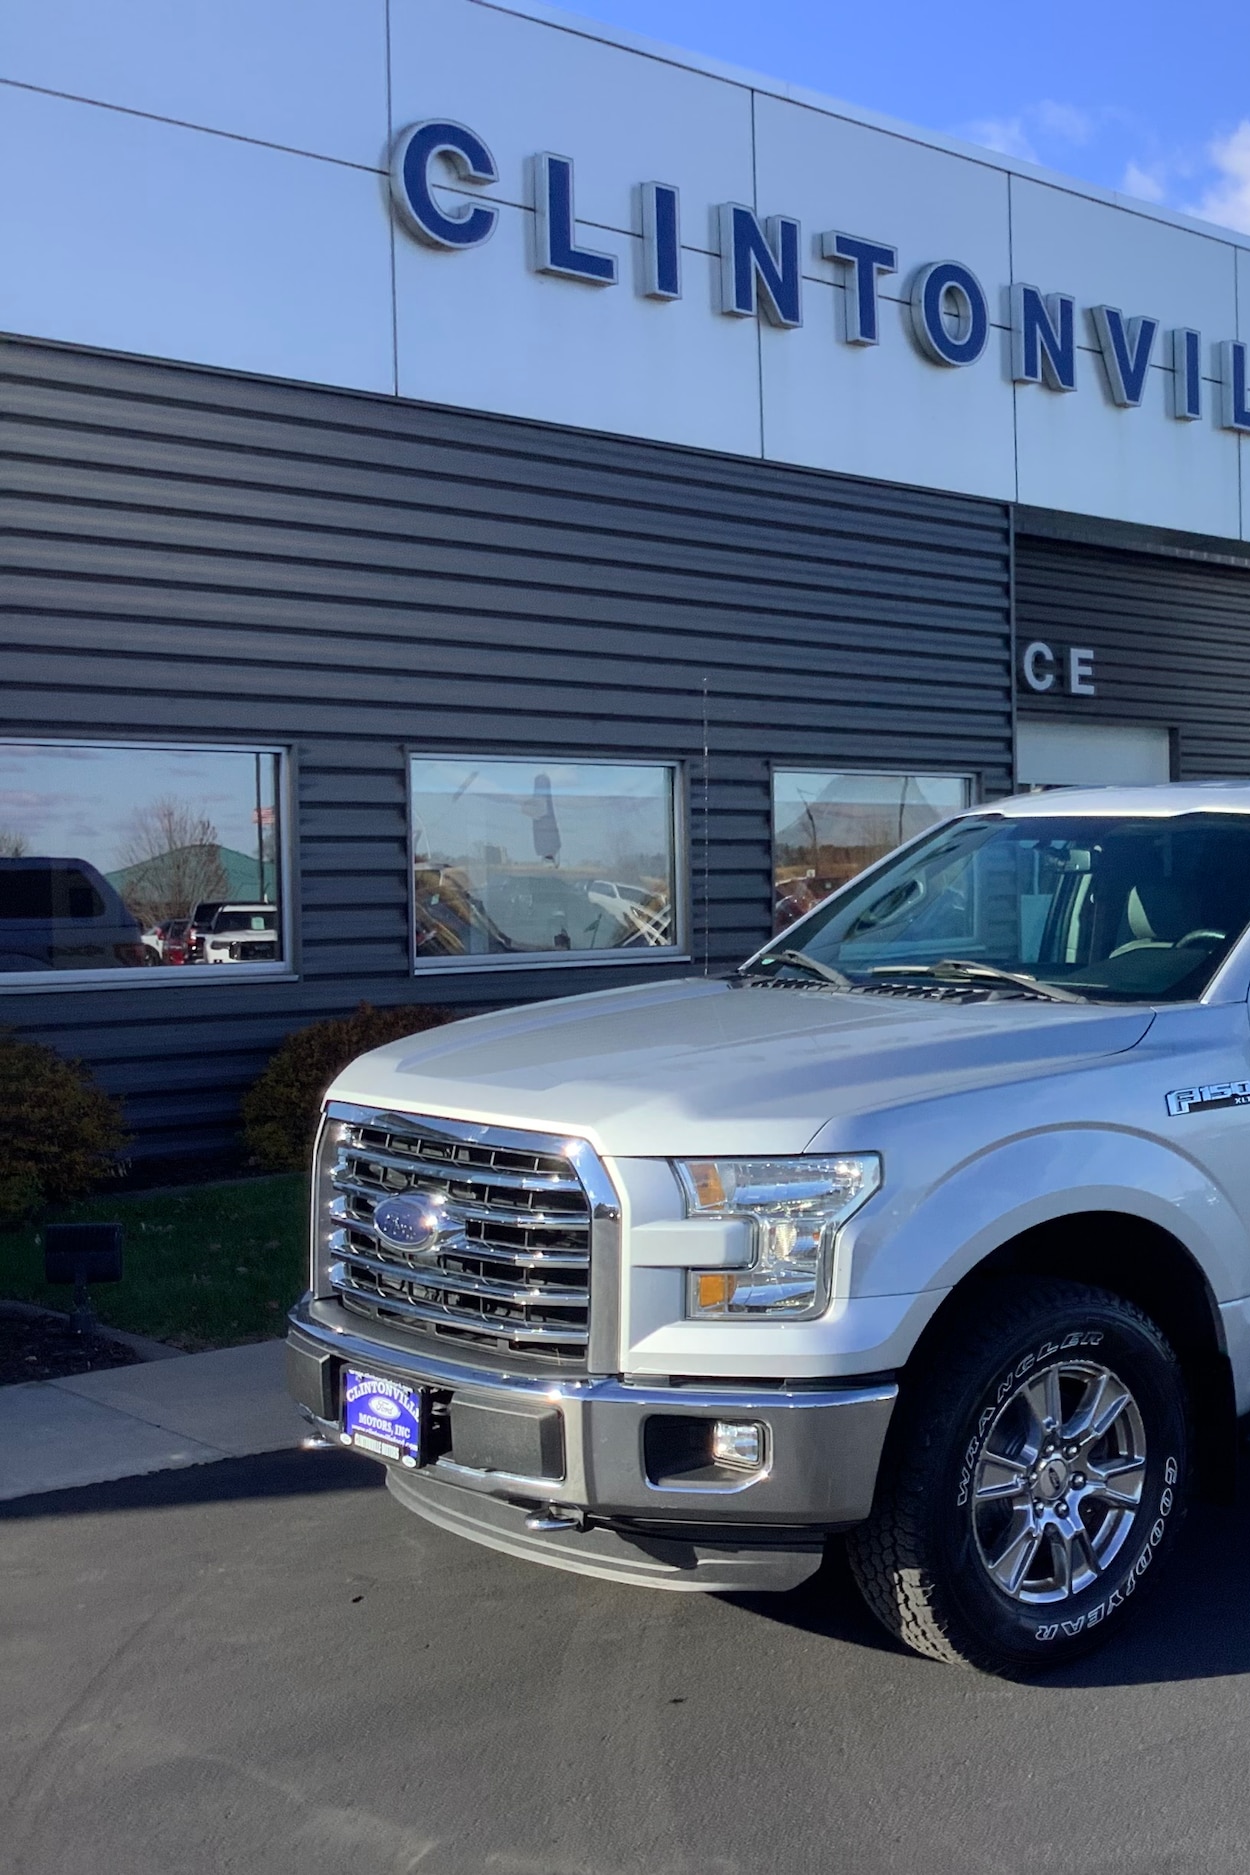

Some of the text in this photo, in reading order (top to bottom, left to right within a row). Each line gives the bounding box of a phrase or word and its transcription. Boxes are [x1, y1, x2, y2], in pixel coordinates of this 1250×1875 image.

[358, 1412, 411, 1439] MOTORS, INC
[957, 1331, 1103, 1506] WRANGLER
[1035, 1456, 1178, 1641] GOODYEAR
